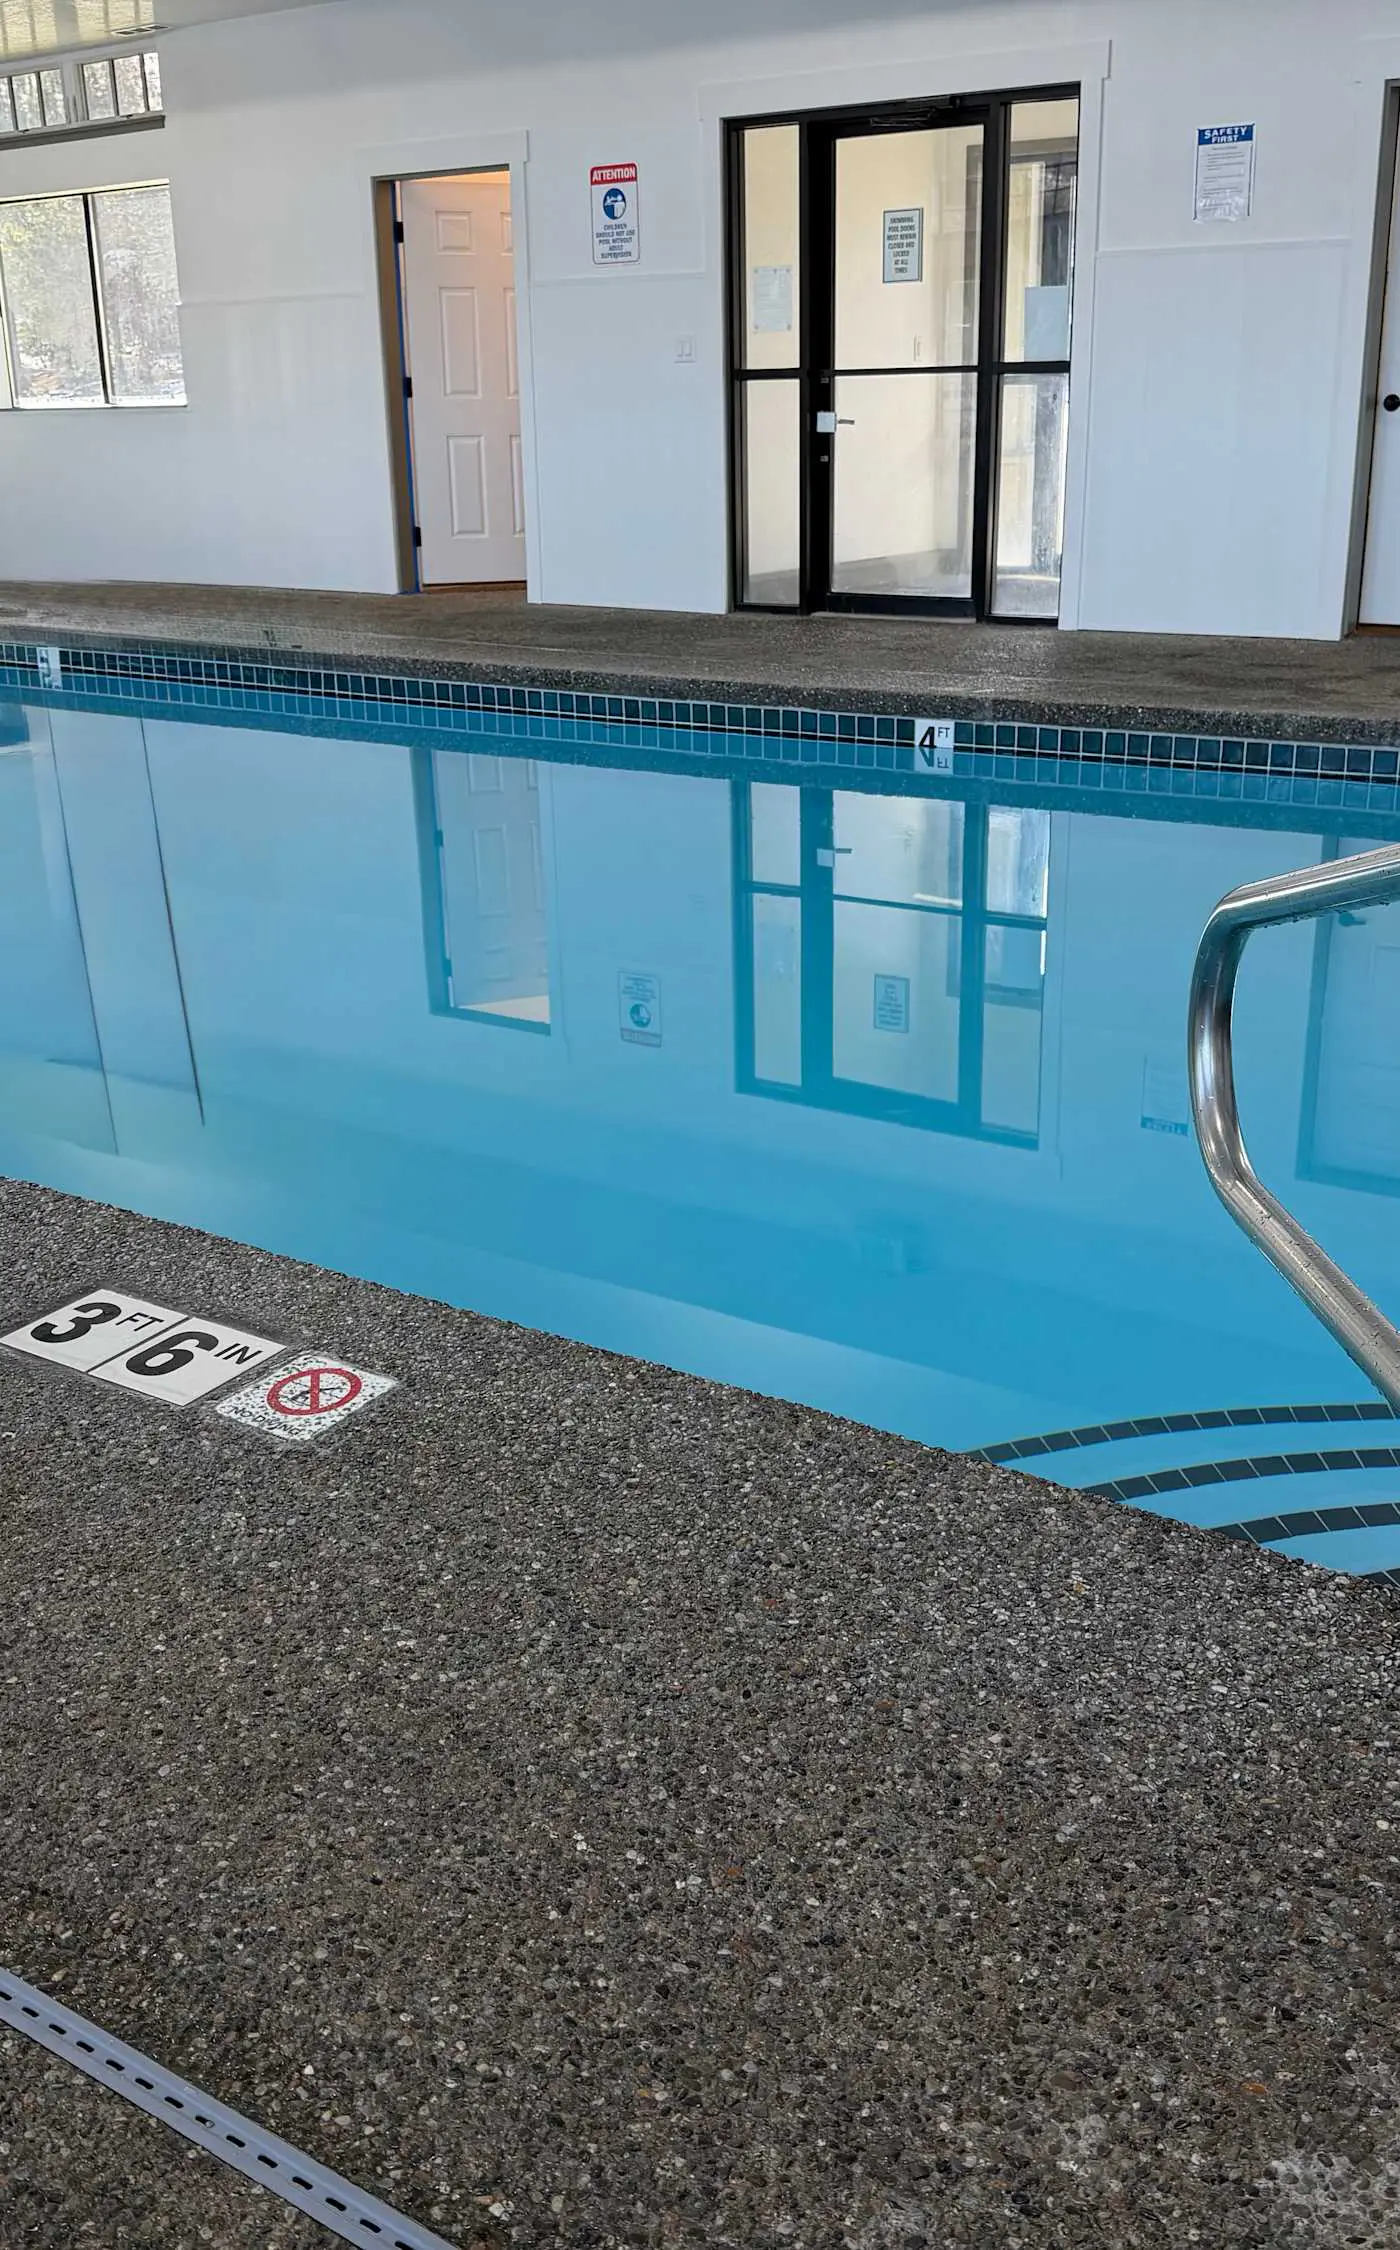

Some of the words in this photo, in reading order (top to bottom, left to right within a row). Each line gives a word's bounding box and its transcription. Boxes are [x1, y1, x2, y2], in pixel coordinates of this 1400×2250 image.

[1204, 126, 1247, 140] SAFETY
[1211, 134, 1239, 144] FIRST
[592, 167, 636, 182] ATTENTION
[919, 726, 936, 748] 4
[937, 727, 951, 738] FT
[30, 1302, 122, 1343] 3
[115, 1312, 165, 1332] FT
[125, 1331, 219, 1376] 6
[213, 1342, 264, 1365] IN
[227, 1406, 252, 1418] NO
